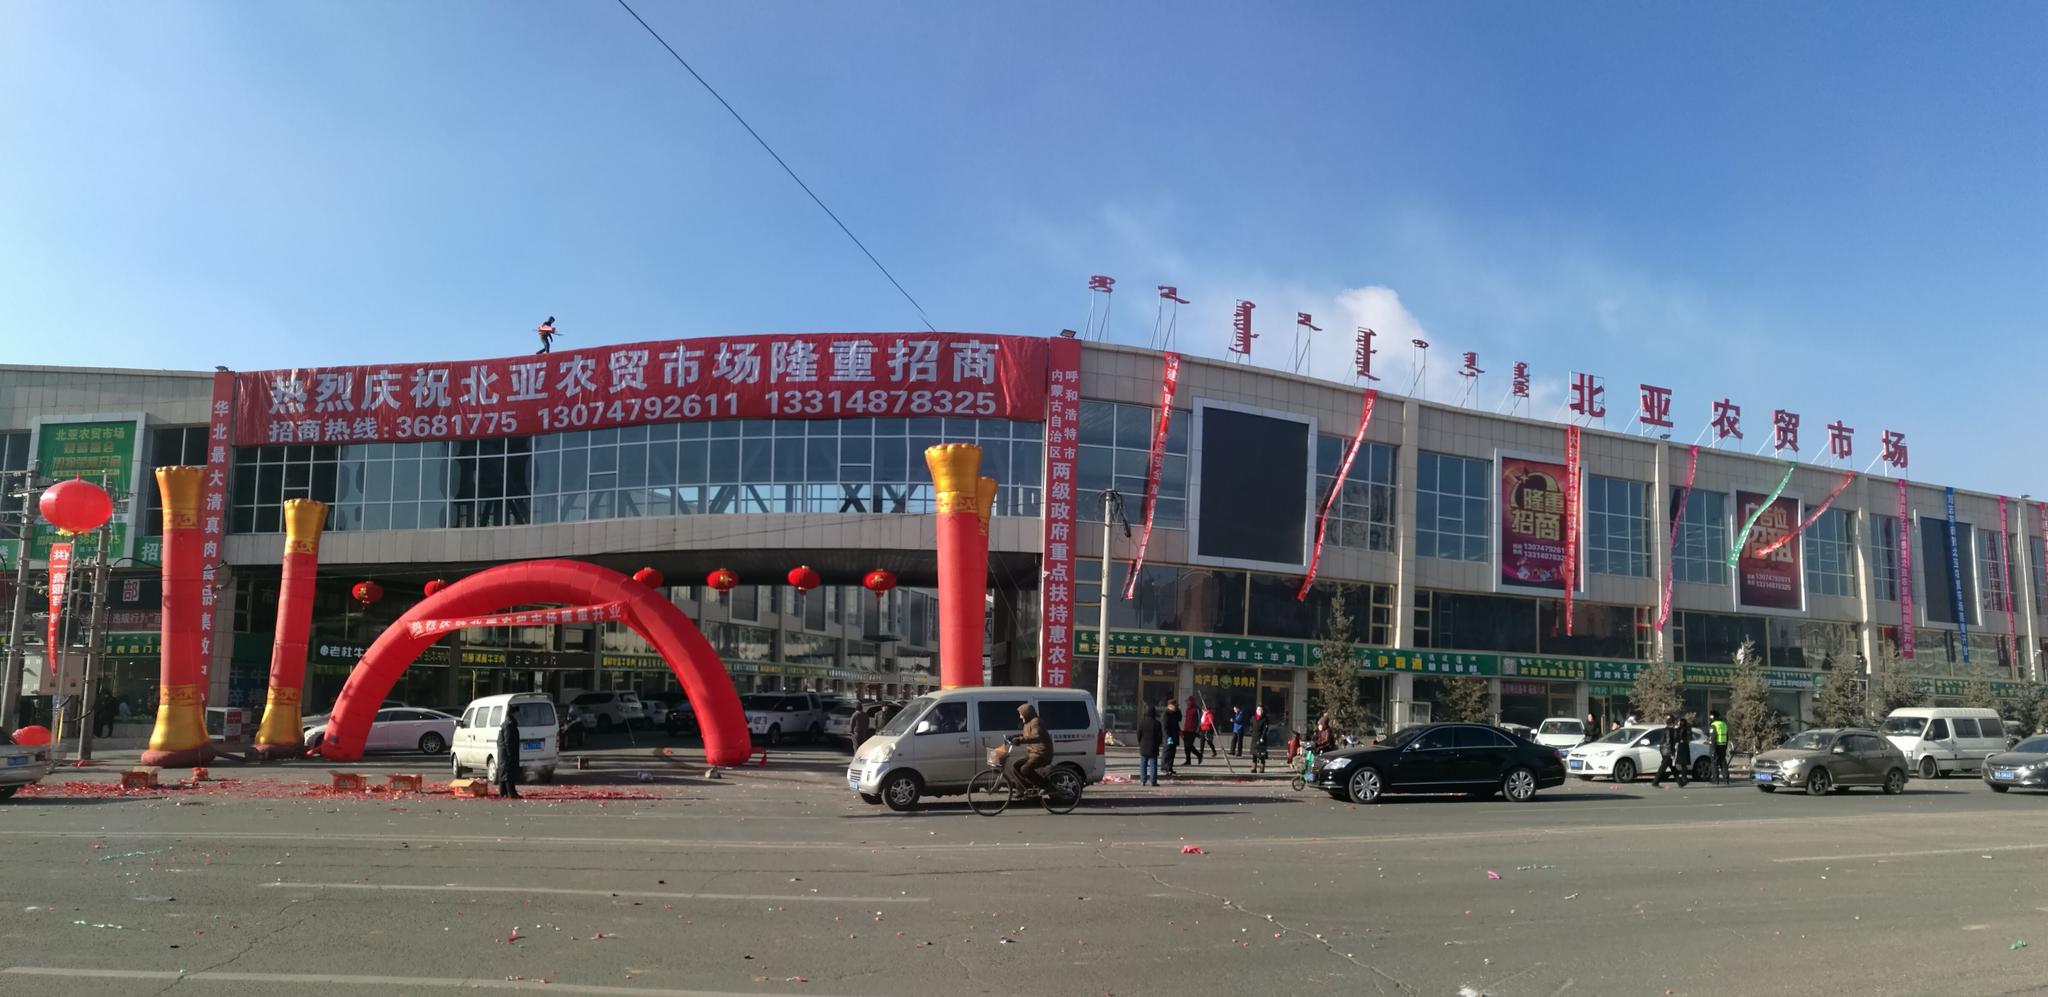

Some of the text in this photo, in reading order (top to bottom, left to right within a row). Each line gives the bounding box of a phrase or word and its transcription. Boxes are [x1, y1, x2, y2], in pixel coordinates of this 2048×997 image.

[268, 338, 1000, 415] 热烈庆祝北亚农贸市场隆重招商
[538, 393, 738, 428] 13074792611
[766, 391, 998, 415] 13314878325
[1050, 369, 1063, 460] 内蒙古自治区
[1064, 369, 1079, 460] 呼和浩特市
[1570, 373, 1909, 469] 北亚农贸市场
[1047, 462, 1072, 686] 两级政府重点扶持惠农市
